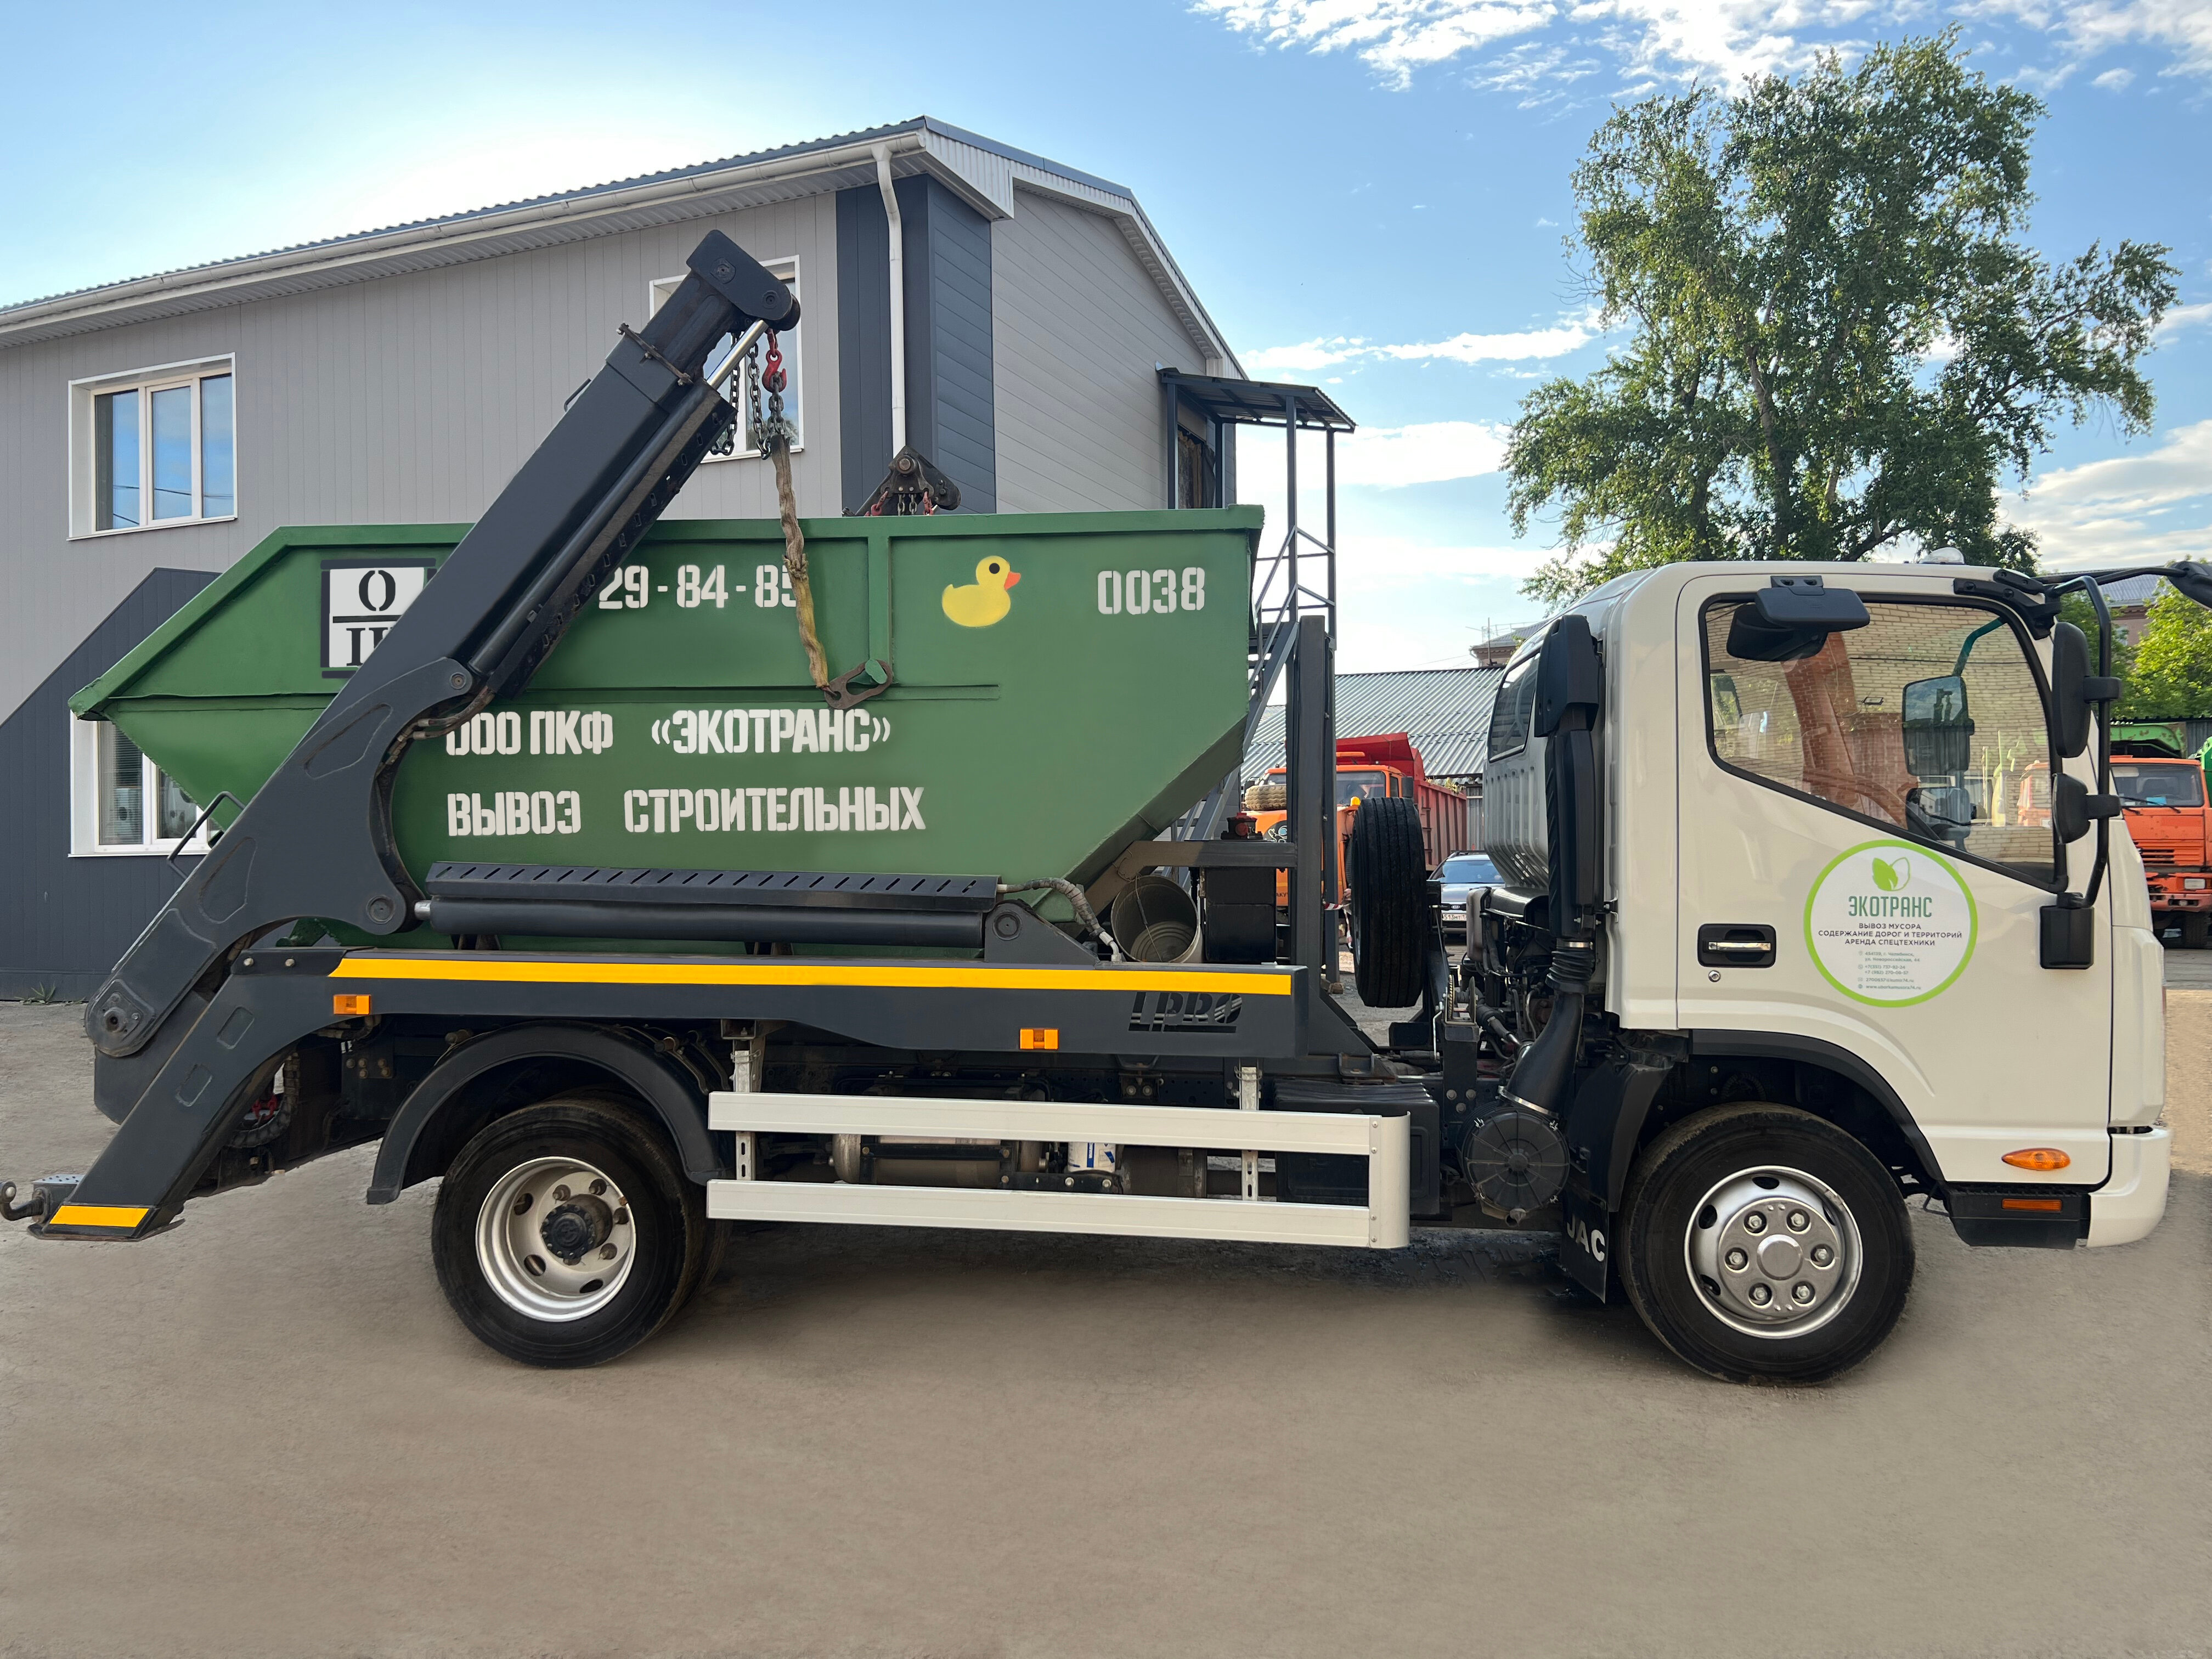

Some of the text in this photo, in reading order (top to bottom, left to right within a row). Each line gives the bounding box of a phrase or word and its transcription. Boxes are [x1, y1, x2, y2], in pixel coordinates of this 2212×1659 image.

[1098, 567, 1205, 614] 0038
[446, 709, 890, 755] ООО ПКФ «ЭКОТРАНС»
[624, 787, 926, 833] СТРОИТЕЛЬНЫХ
[1848, 895, 1932, 917] ЭКОТРАНС
[1567, 1214, 1605, 1261] JAC
